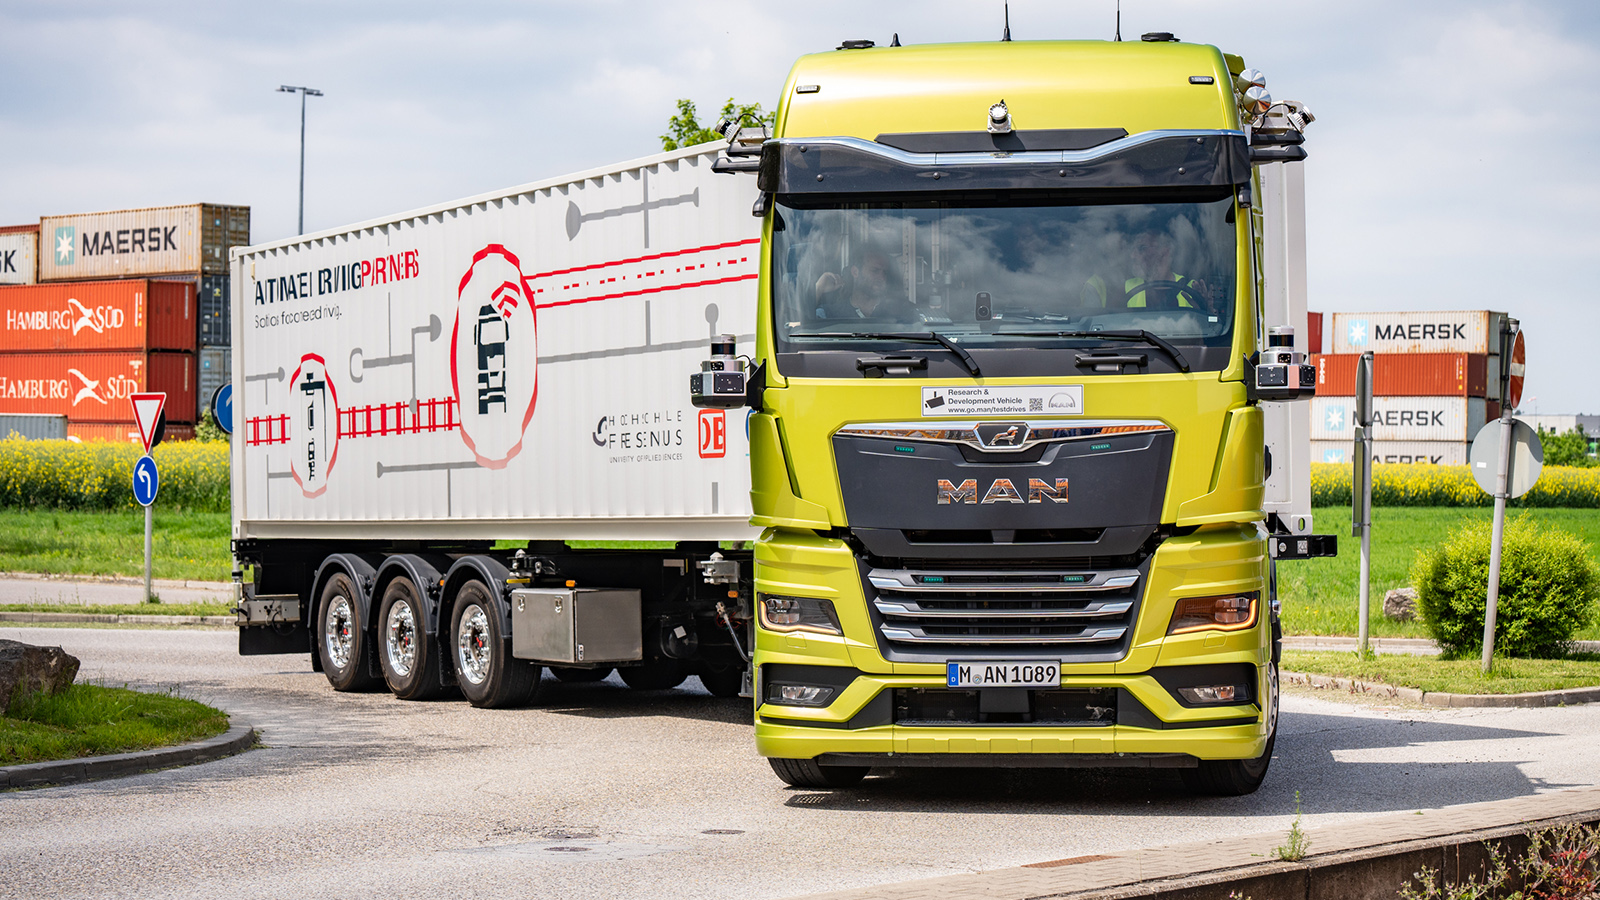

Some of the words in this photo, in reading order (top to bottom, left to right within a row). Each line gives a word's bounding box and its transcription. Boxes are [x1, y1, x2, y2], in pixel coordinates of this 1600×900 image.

[82, 225, 177, 256] MAERSK
[0, 249, 17, 273] K
[7, 309, 70, 330] HAMBURG
[96, 305, 124, 329] SÜD
[1375, 323, 1466, 340] MAERSK
[0, 376, 68, 399] HAMBURG
[107, 374, 138, 399] SÜD
[937, 477, 1069, 505] MAN
[959, 666, 971, 683] M
[984, 666, 1007, 683] AN
[1011, 666, 1056, 683] 1089
